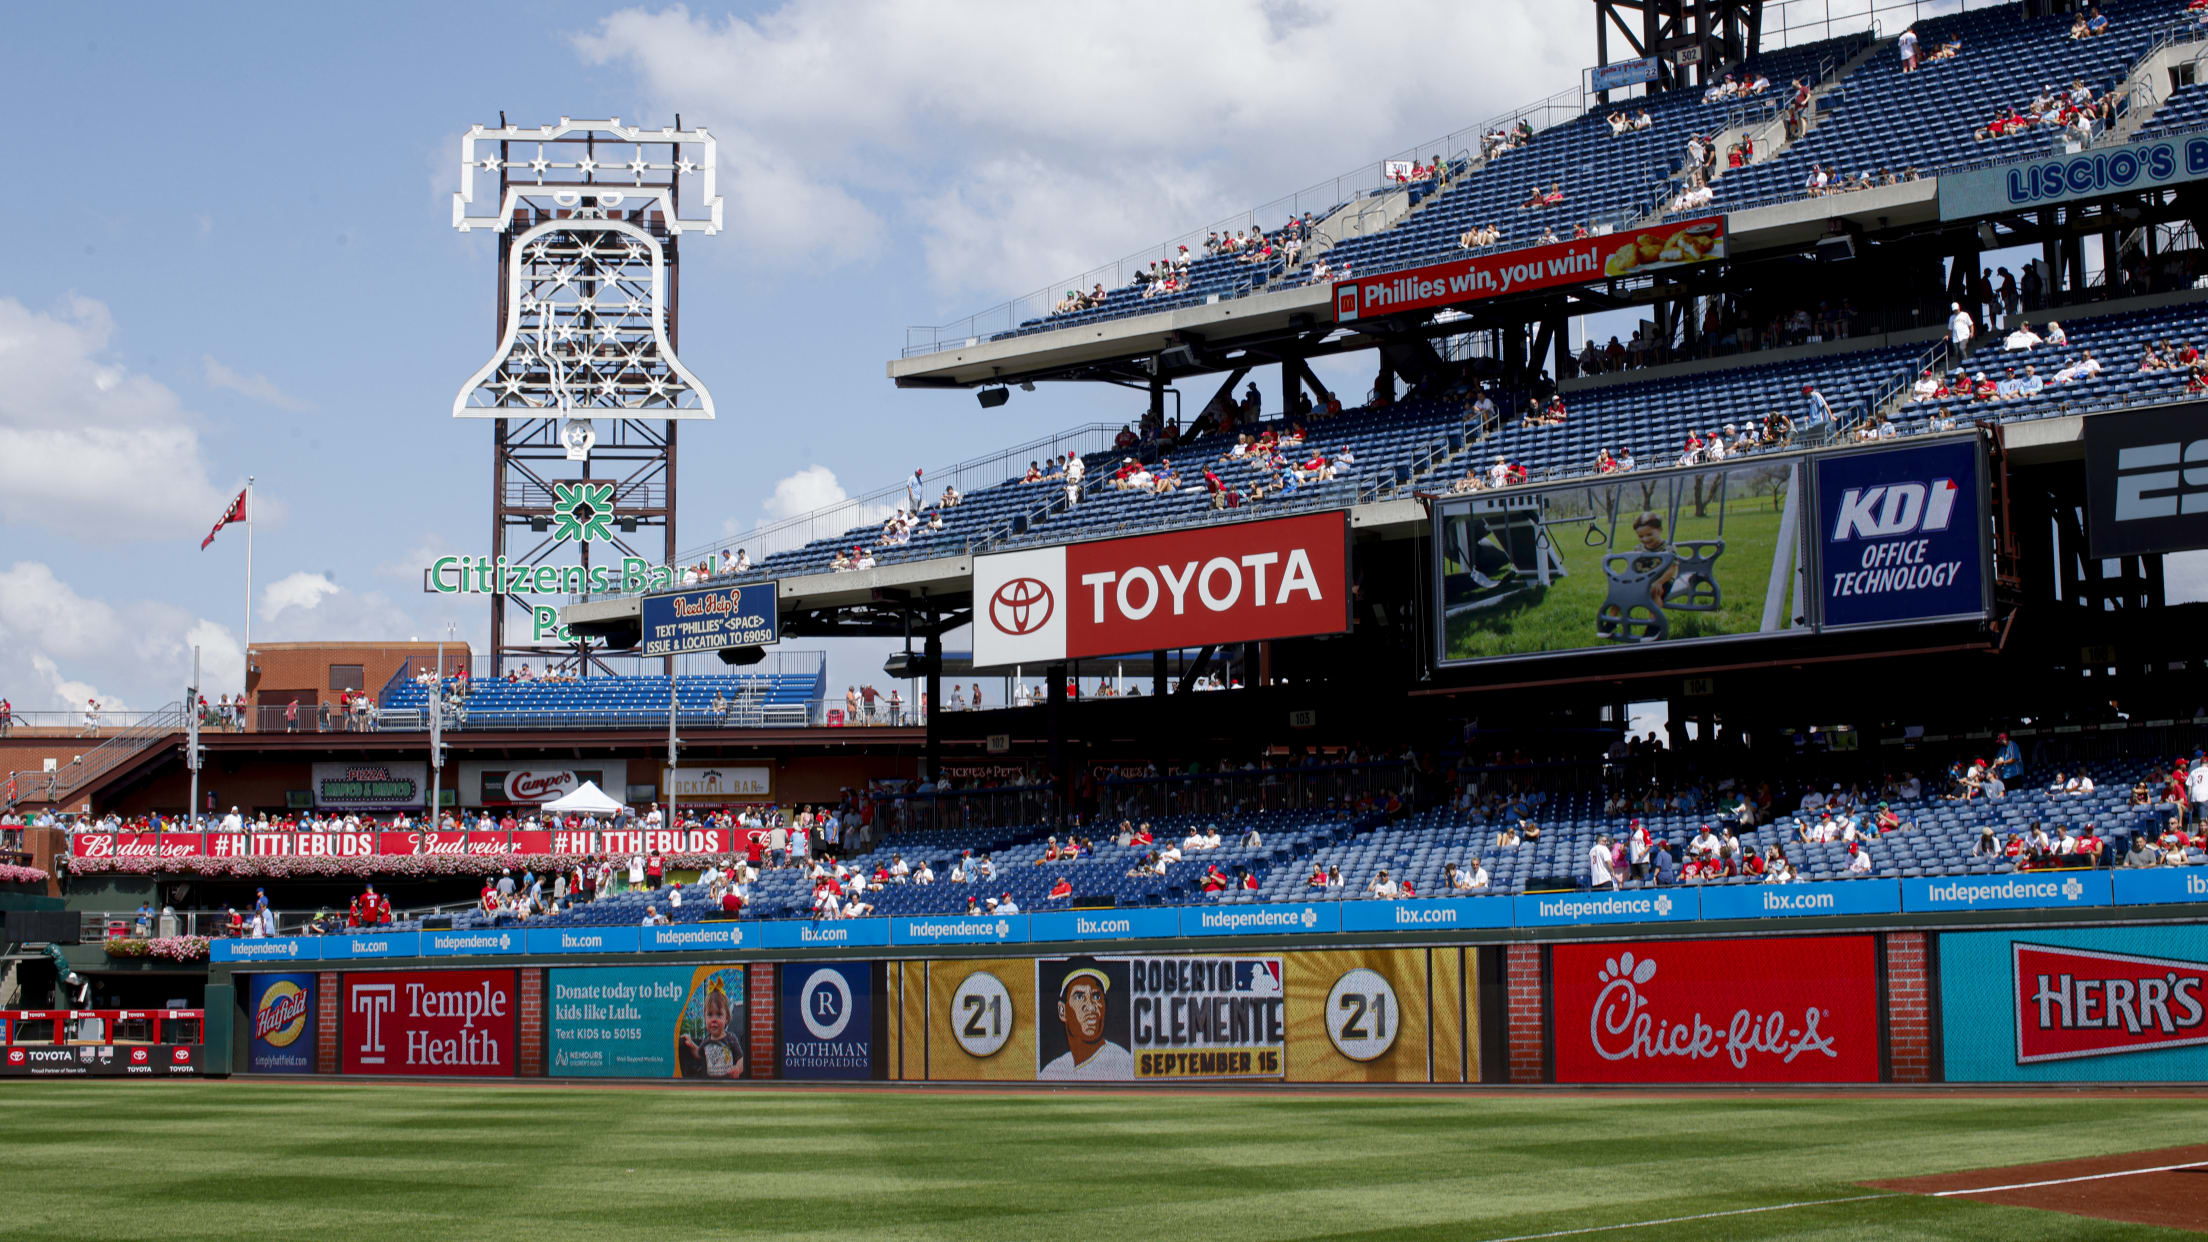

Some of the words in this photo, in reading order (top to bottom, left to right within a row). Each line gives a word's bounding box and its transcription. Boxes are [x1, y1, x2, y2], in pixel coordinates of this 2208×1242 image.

[1682, 50, 1696, 61] 302
[2007, 143, 2175, 203] LISCIO'S
[1365, 276, 1446, 308] Phillies
[1449, 265, 1498, 293] win,
[1500, 260, 1544, 292] you
[1547, 247, 1599, 276] win!
[1831, 478, 1958, 542] KDI
[1862, 539, 1930, 569] OFFICE
[430, 555, 610, 594] Citizens
[1082, 548, 1323, 623] TOYOTA
[1832, 561, 1962, 597] TECHNOLOGY
[674, 597, 703, 618] Need
[705, 588, 742, 618] Help?
[655, 624, 677, 638] TEXT
[725, 615, 765, 631] <SPACE>
[647, 640, 671, 653] ISSUE
[674, 639, 680, 651] &
[683, 633, 727, 650] LOCATION
[729, 631, 742, 644] TO
[743, 629, 772, 643] 69050
[1295, 712, 1311, 725] 103
[991, 737, 1004, 749] 102
[349, 769, 386, 781] PIZZA
[512, 771, 571, 799] Campo's
[734, 781, 758, 793] BAR
[81, 833, 195, 859] Budweiser
[215, 833, 372, 857] #HITTHEBUDS
[408, 832, 522, 857] Budweiser
[554, 829, 720, 854] #HITTHEBUDS
[1763, 891, 1834, 910] ibx.com
[1929, 880, 2058, 904] Independence
[1202, 908, 1298, 929] Independence
[1396, 906, 1457, 924] ibx.com
[1540, 897, 1650, 919] Independence
[801, 926, 847, 941] ibx.com
[909, 921, 993, 938] Independence
[1077, 917, 1130, 934] ibx.com
[231, 942, 288, 956] Independence
[352, 939, 388, 954] ibx.com
[435, 935, 498, 951] Independence
[561, 933, 602, 948] ibx.com
[656, 929, 729, 946] Independence
[1133, 960, 1233, 992] ROBERTO
[556, 984, 600, 999] Donate
[602, 982, 637, 1002] today
[639, 984, 652, 998] to
[654, 981, 683, 1002] help
[2031, 971, 2205, 1035] HERR'S
[256, 989, 308, 1039] Hatfield
[406, 980, 506, 1027] Temple
[555, 1003, 582, 1020] kids
[584, 1004, 607, 1019] like
[609, 1002, 641, 1019] Lulu.
[818, 991, 837, 1016] R
[963, 994, 1001, 1038] 21
[1133, 996, 1284, 1045] CLEMENTE
[1339, 992, 1387, 1041] 21
[1590, 976, 1838, 1069] Chick-fil-A
[555, 1028, 574, 1040] Text
[577, 1028, 599, 1040] KIDS
[601, 1029, 611, 1039] to
[614, 1028, 641, 1040] 50155
[29, 1051, 73, 1062] TOYOTA
[406, 1028, 500, 1065] Health
[785, 1042, 868, 1057] ROTHMAN
[170, 1065, 195, 1073] TOYOTA
[785, 1058, 868, 1068] ORTHOPAEDICS
[1141, 1053, 1251, 1075] SEPTEMBER
[1258, 1051, 1278, 1072] 15
